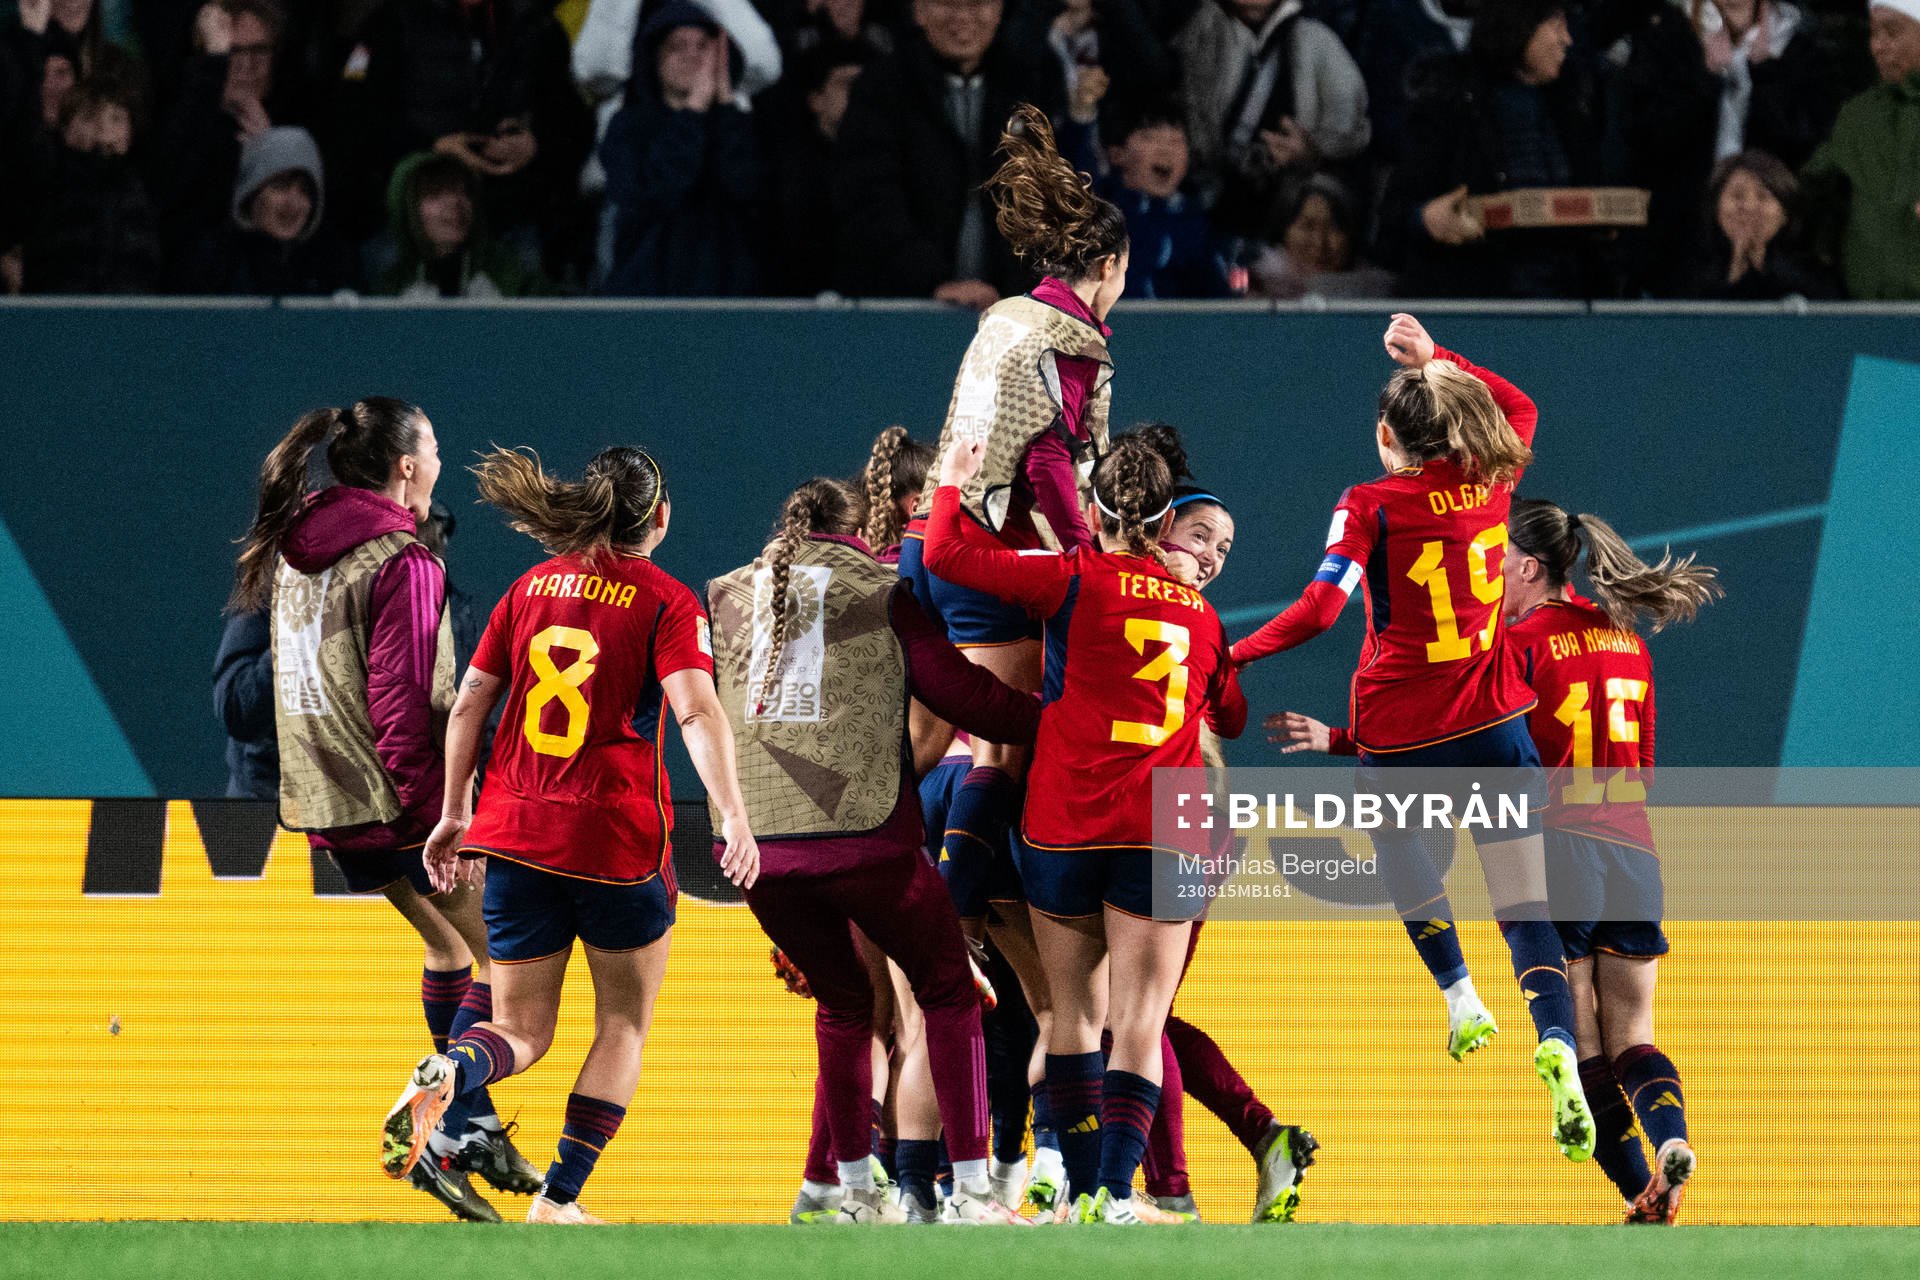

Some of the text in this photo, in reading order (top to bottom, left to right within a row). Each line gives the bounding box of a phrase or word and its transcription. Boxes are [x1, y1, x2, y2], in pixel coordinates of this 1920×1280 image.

[1428, 484, 1489, 515] OLGA
[526, 573, 637, 609] MARIONA
[1117, 571, 1204, 613] TERESA
[1406, 522, 1508, 663] 19
[1111, 618, 1190, 746] 3
[1548, 632, 1582, 660] EVA
[524, 625, 600, 758] 8
[1554, 678, 1648, 805] 15
